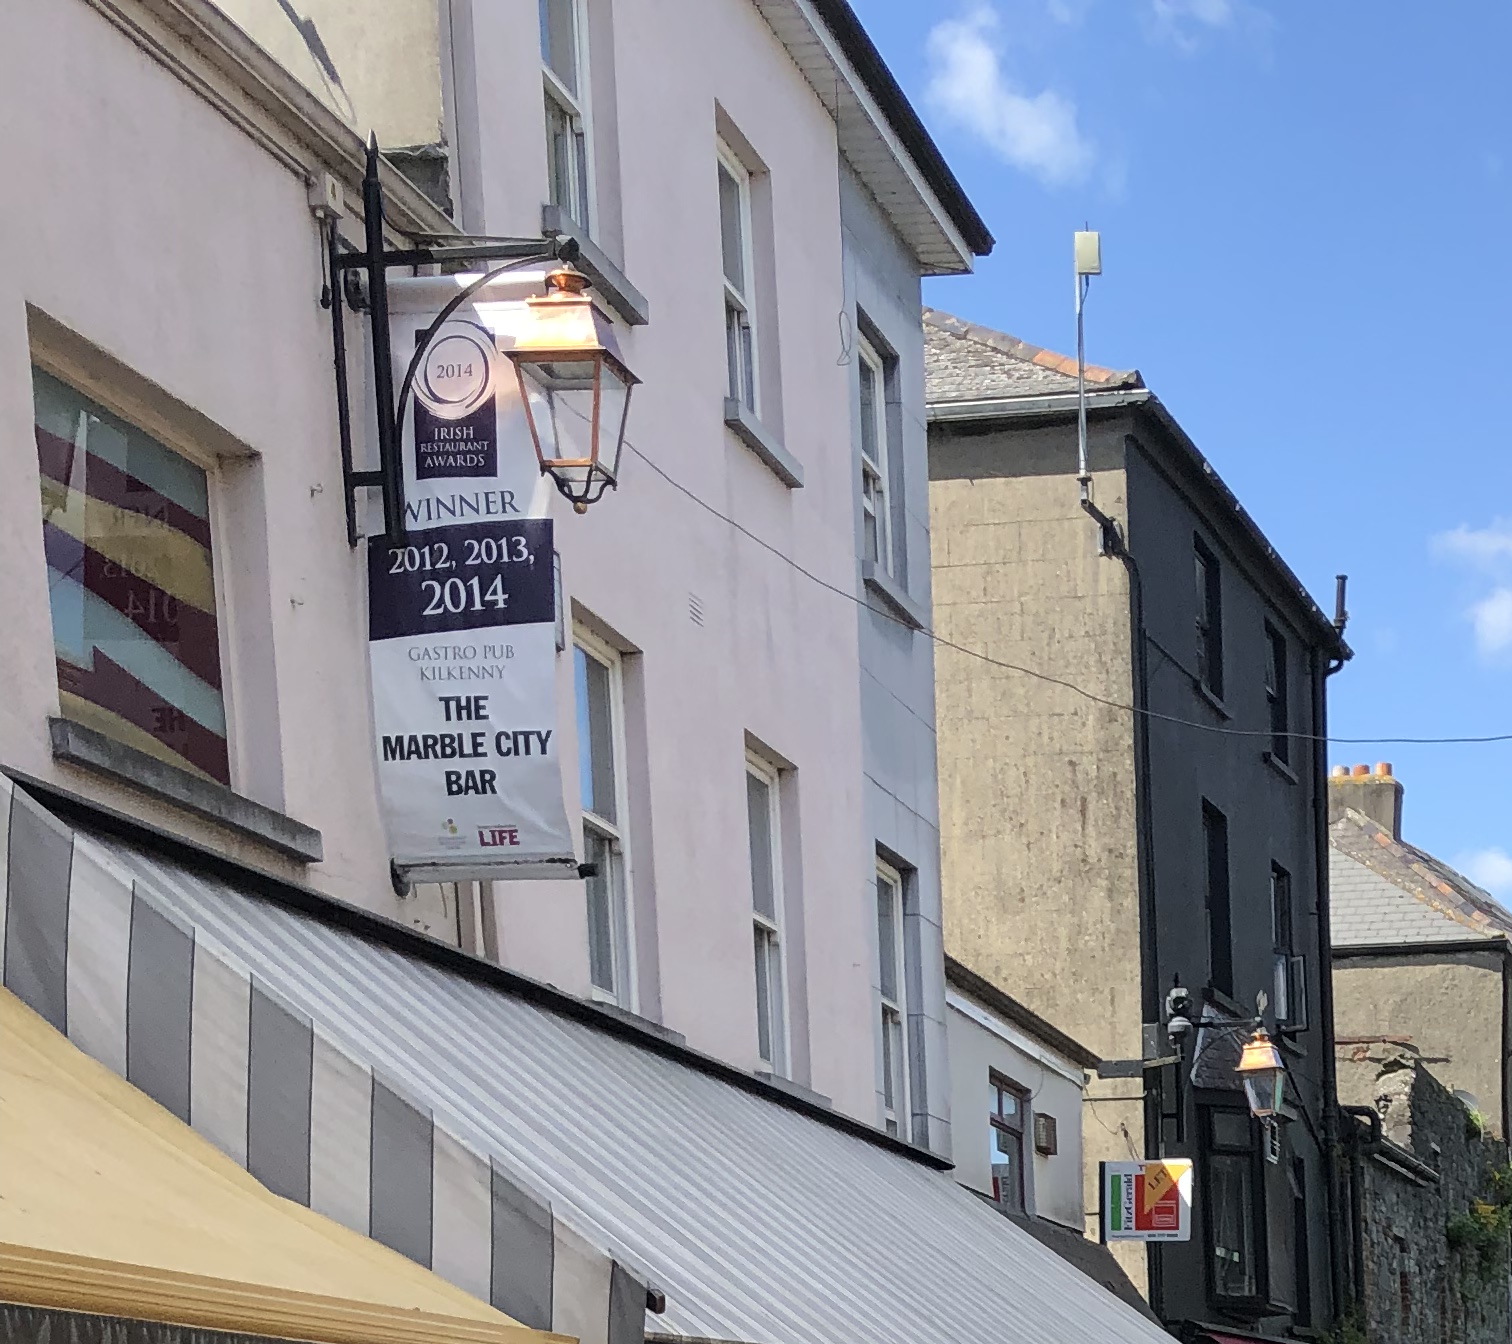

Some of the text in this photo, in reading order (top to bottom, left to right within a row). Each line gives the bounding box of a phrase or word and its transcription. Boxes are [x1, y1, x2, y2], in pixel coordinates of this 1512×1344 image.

[436, 363, 473, 379] 2014
[434, 426, 474, 439] IRISH
[420, 440, 489, 453] RESTAURANT
[425, 454, 485, 468] AWARDS
[388, 536, 534, 574] 2012, 2013,
[421, 573, 509, 616] 2014
[408, 644, 515, 661] GASTRO PUB
[420, 665, 506, 681] KILKENNY
[438, 695, 490, 722] THE
[382, 730, 552, 761] MARBLE CITY
[445, 769, 498, 796] BAR
[477, 828, 521, 847] LIFE
[1148, 1169, 1167, 1191] LET
